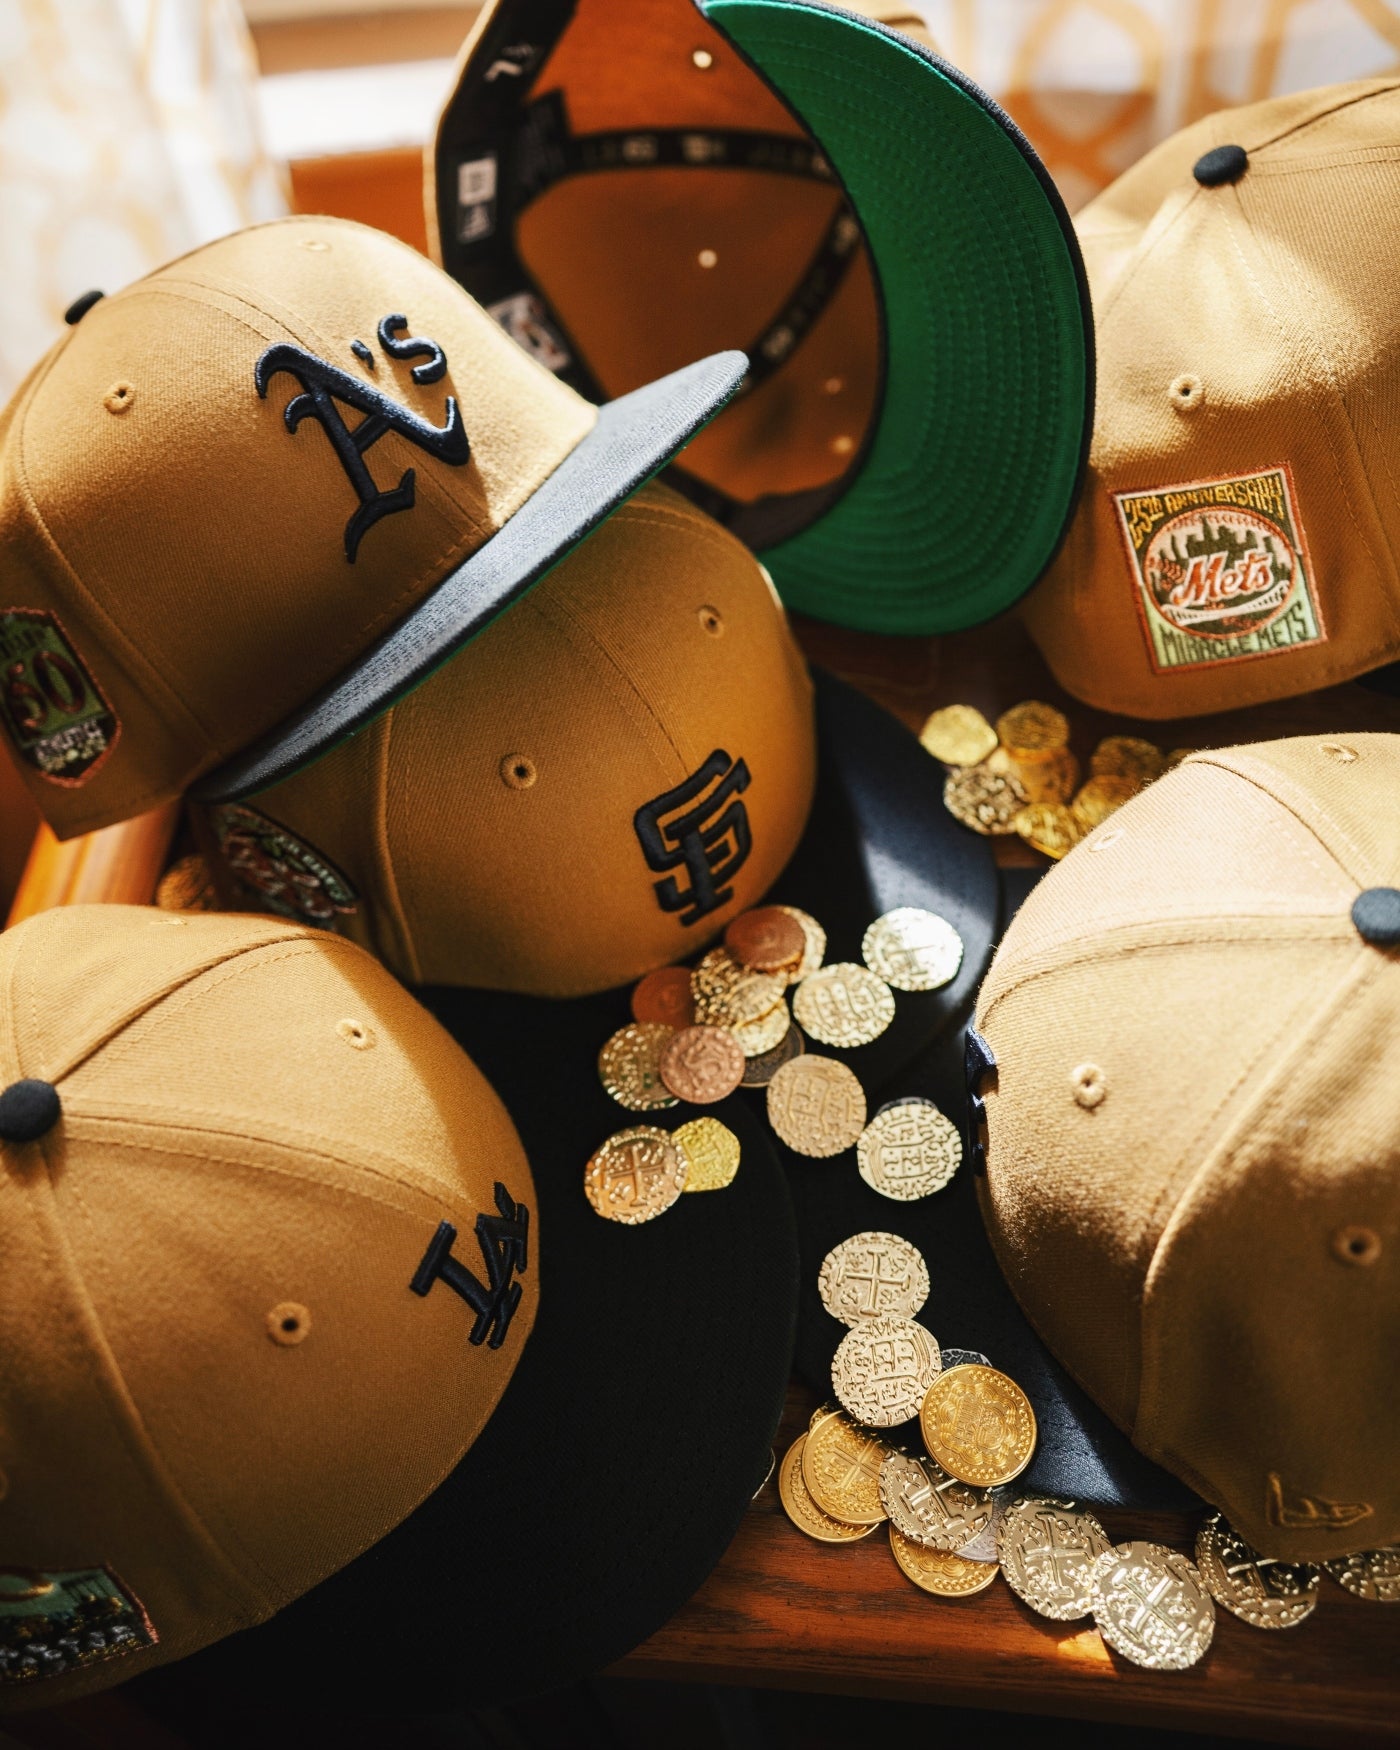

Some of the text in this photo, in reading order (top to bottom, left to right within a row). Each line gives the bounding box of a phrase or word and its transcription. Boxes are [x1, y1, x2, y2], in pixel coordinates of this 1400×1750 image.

[255, 312, 470, 564] A's
[1164, 475, 1284, 520] ANNIVERSARY
[1171, 551, 1273, 608] Mets
[1158, 601, 1309, 667] MIRACLE METS
